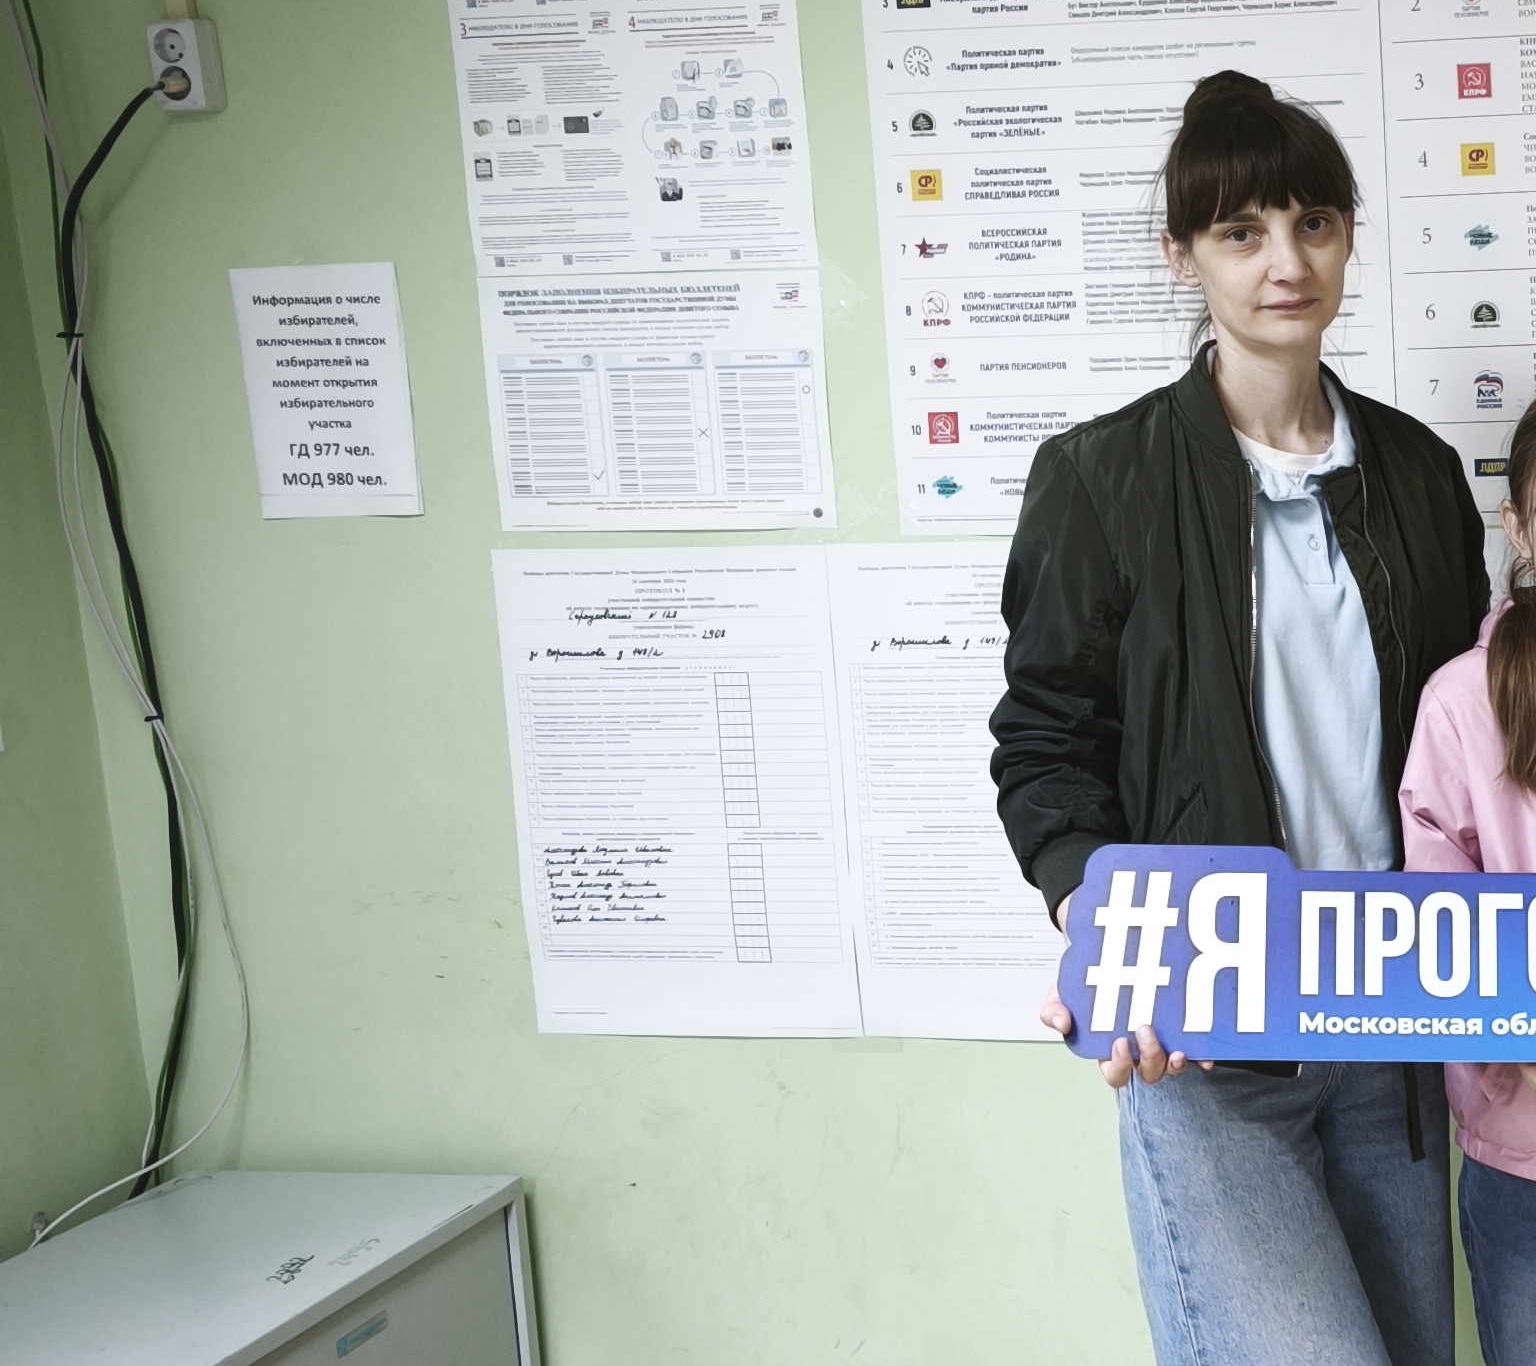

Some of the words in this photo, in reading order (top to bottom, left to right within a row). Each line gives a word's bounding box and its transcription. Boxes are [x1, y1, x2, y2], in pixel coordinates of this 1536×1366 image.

[1414, 73, 1424, 90] 3
[1417, 150, 1428, 167] 4
[1421, 227, 1431, 244] 5
[252, 295, 332, 306] Информация
[335, 295, 342, 304] о
[345, 295, 380, 304] числе
[1425, 303, 1435, 320] 6
[278, 314, 358, 326] избирателей,
[256, 338, 332, 346] включенных
[335, 337, 342, 345] в
[344, 337, 386, 345] список
[276, 355, 352, 368] избирателей
[355, 358, 369, 366] на
[272, 379, 320, 387] момент
[322, 379, 377, 388] открытия
[1429, 378, 1439, 395] 7
[279, 397, 374, 409] избирательного
[307, 420, 352, 430] участка
[289, 443, 310, 459] ГД
[313, 442, 340, 456] 977
[344, 445, 374, 456] чел.
[282, 472, 324, 488] МОД
[326, 472, 353, 485] 980
[356, 475, 387, 485] чел.
[1085, 871, 1267, 1032] #Я
[1299, 1012, 1482, 1034] Московская
